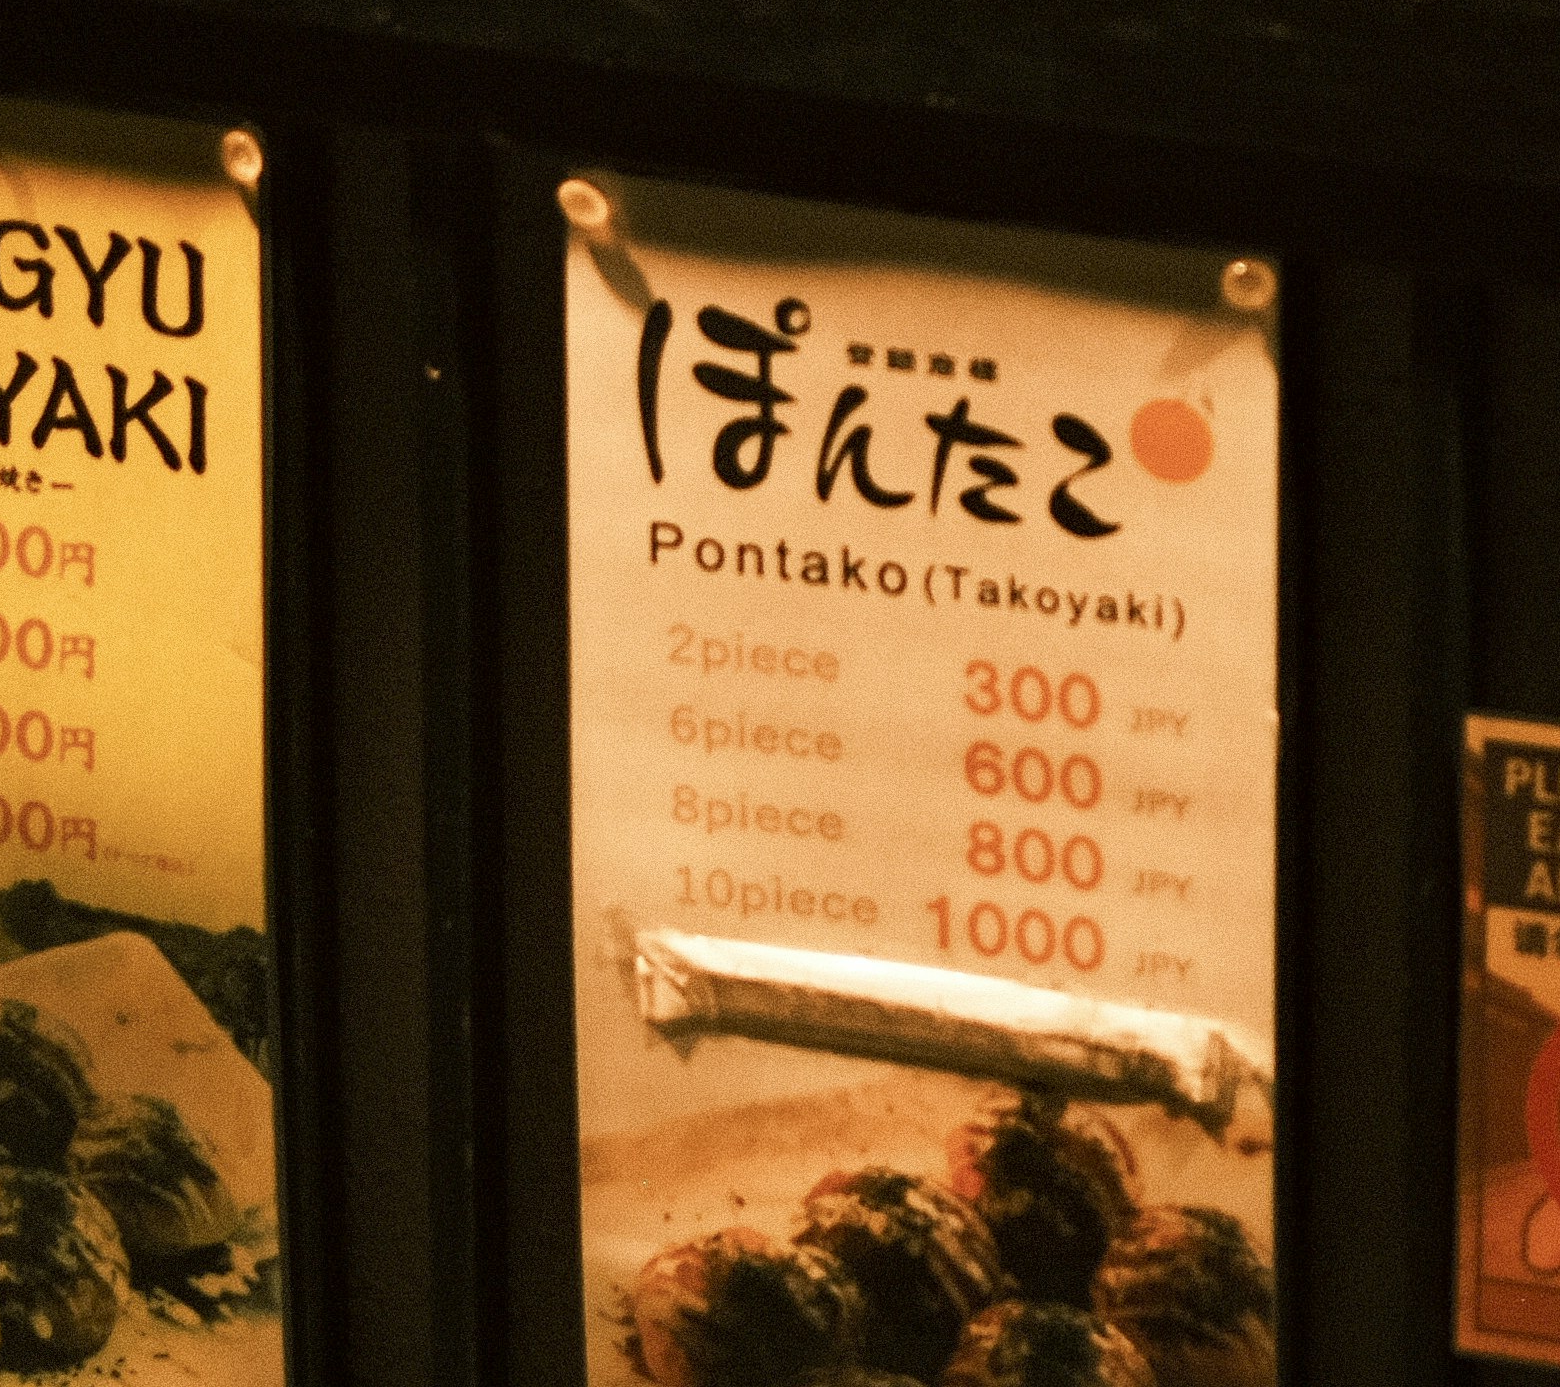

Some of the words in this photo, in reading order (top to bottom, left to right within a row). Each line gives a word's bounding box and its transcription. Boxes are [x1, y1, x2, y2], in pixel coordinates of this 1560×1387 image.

[637, 297, 1123, 540] ぽんたこ
[668, 623, 841, 685] 2piece
[964, 658, 1101, 730] 300
[1130, 707, 1192, 738] JPY
[669, 704, 844, 764] 6piece
[964, 740, 1104, 811] 600
[1130, 787, 1193, 819] JPY
[671, 784, 846, 843] 8piece
[967, 821, 1105, 892] 800
[1133, 868, 1195, 901] JPY
[673, 864, 881, 927] 10piece
[926, 896, 1107, 972] 1000
[1133, 949, 1195, 983] JPY
